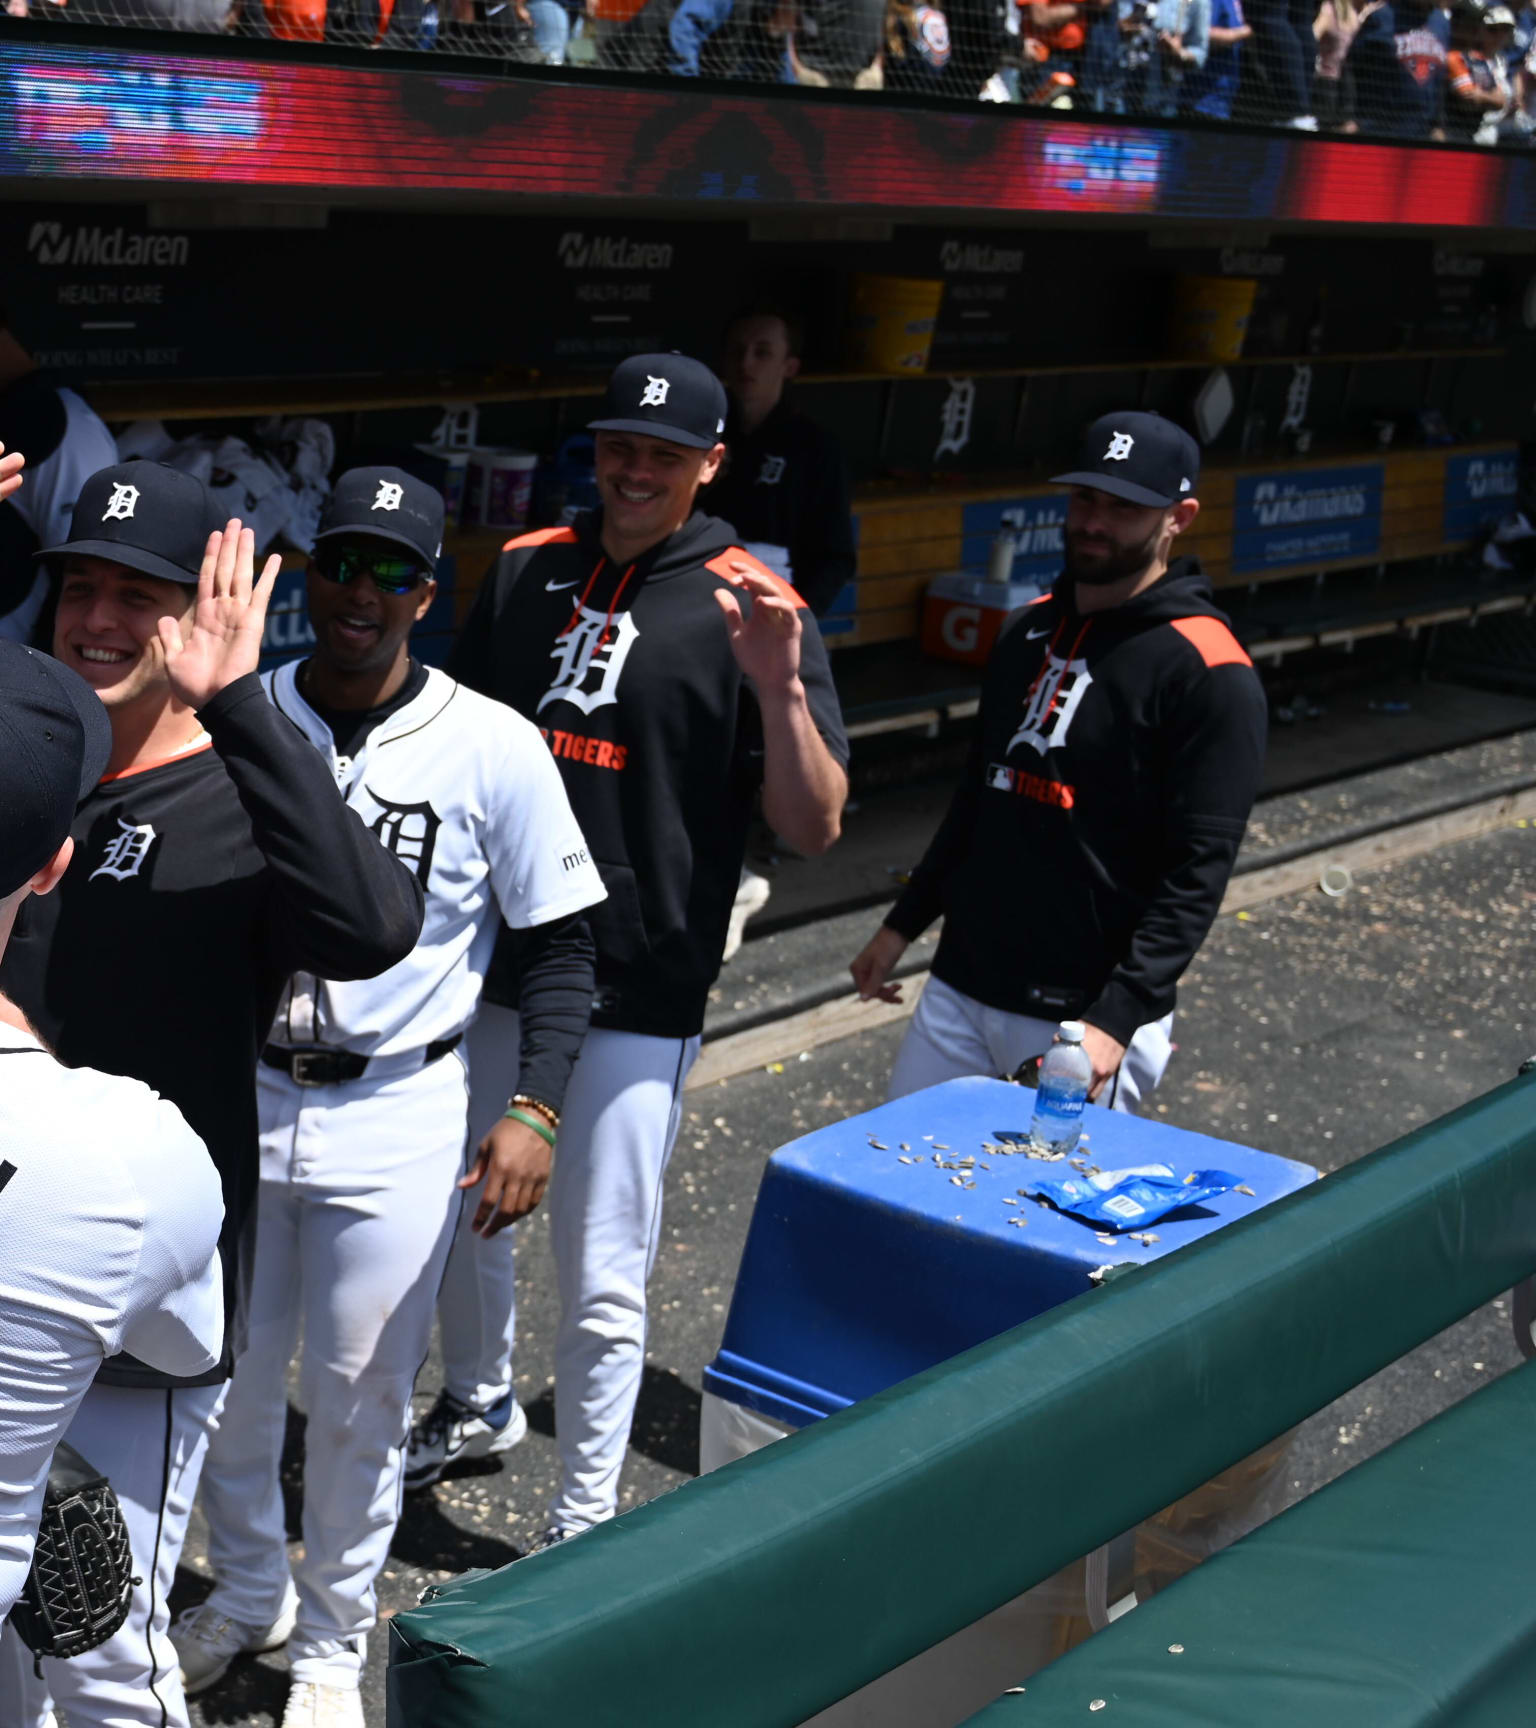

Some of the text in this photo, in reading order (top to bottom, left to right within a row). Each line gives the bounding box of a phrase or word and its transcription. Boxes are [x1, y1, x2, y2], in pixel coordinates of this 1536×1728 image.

[71, 226, 189, 267] McLaren
[589, 236, 674, 270] McLaren
[57, 284, 164, 304] HEALTH CARE
[639, 374, 671, 408] D
[1103, 431, 1135, 462] D
[102, 481, 140, 522] D
[370, 479, 405, 512] D
[940, 605, 982, 653] G
[537, 595, 641, 716] D
[1005, 644, 1094, 758] D
[552, 729, 628, 771] TIGERS
[1016, 769, 1075, 810] TIGERS
[87, 817, 158, 883] D
[562, 848, 588, 871] me
